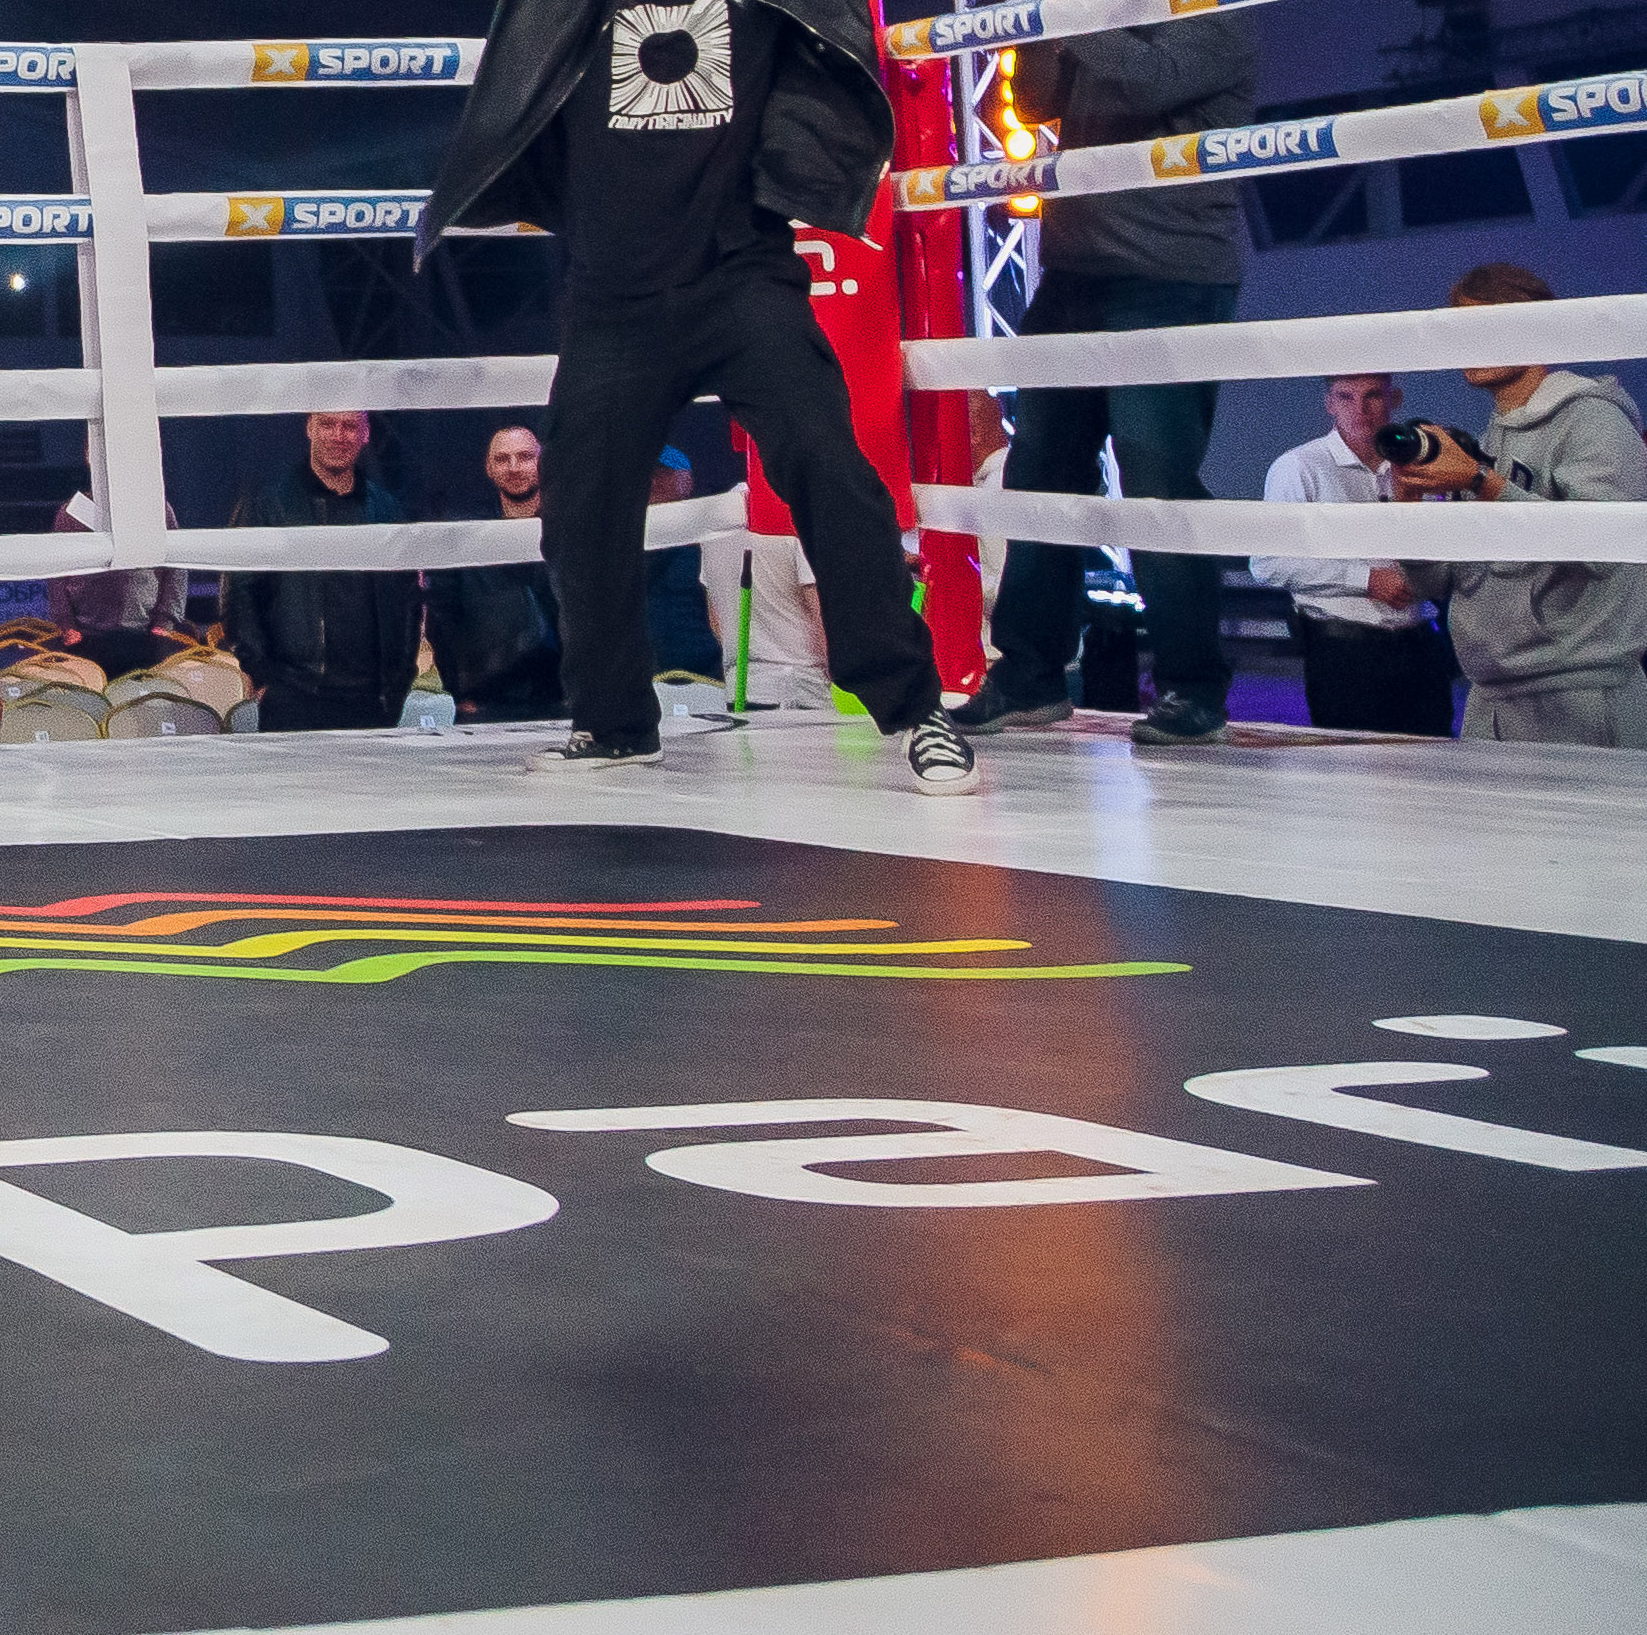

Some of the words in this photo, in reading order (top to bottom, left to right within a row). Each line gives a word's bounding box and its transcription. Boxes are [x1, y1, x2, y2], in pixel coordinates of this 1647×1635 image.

[934, 4, 1037, 46] SPORT
[318, 48, 452, 76] SPORT
[1547, 79, 1647, 120] SPO
[1205, 120, 1331, 165] SPORT
[948, 159, 1053, 195] SPORT
[293, 201, 425, 229] SPORT
